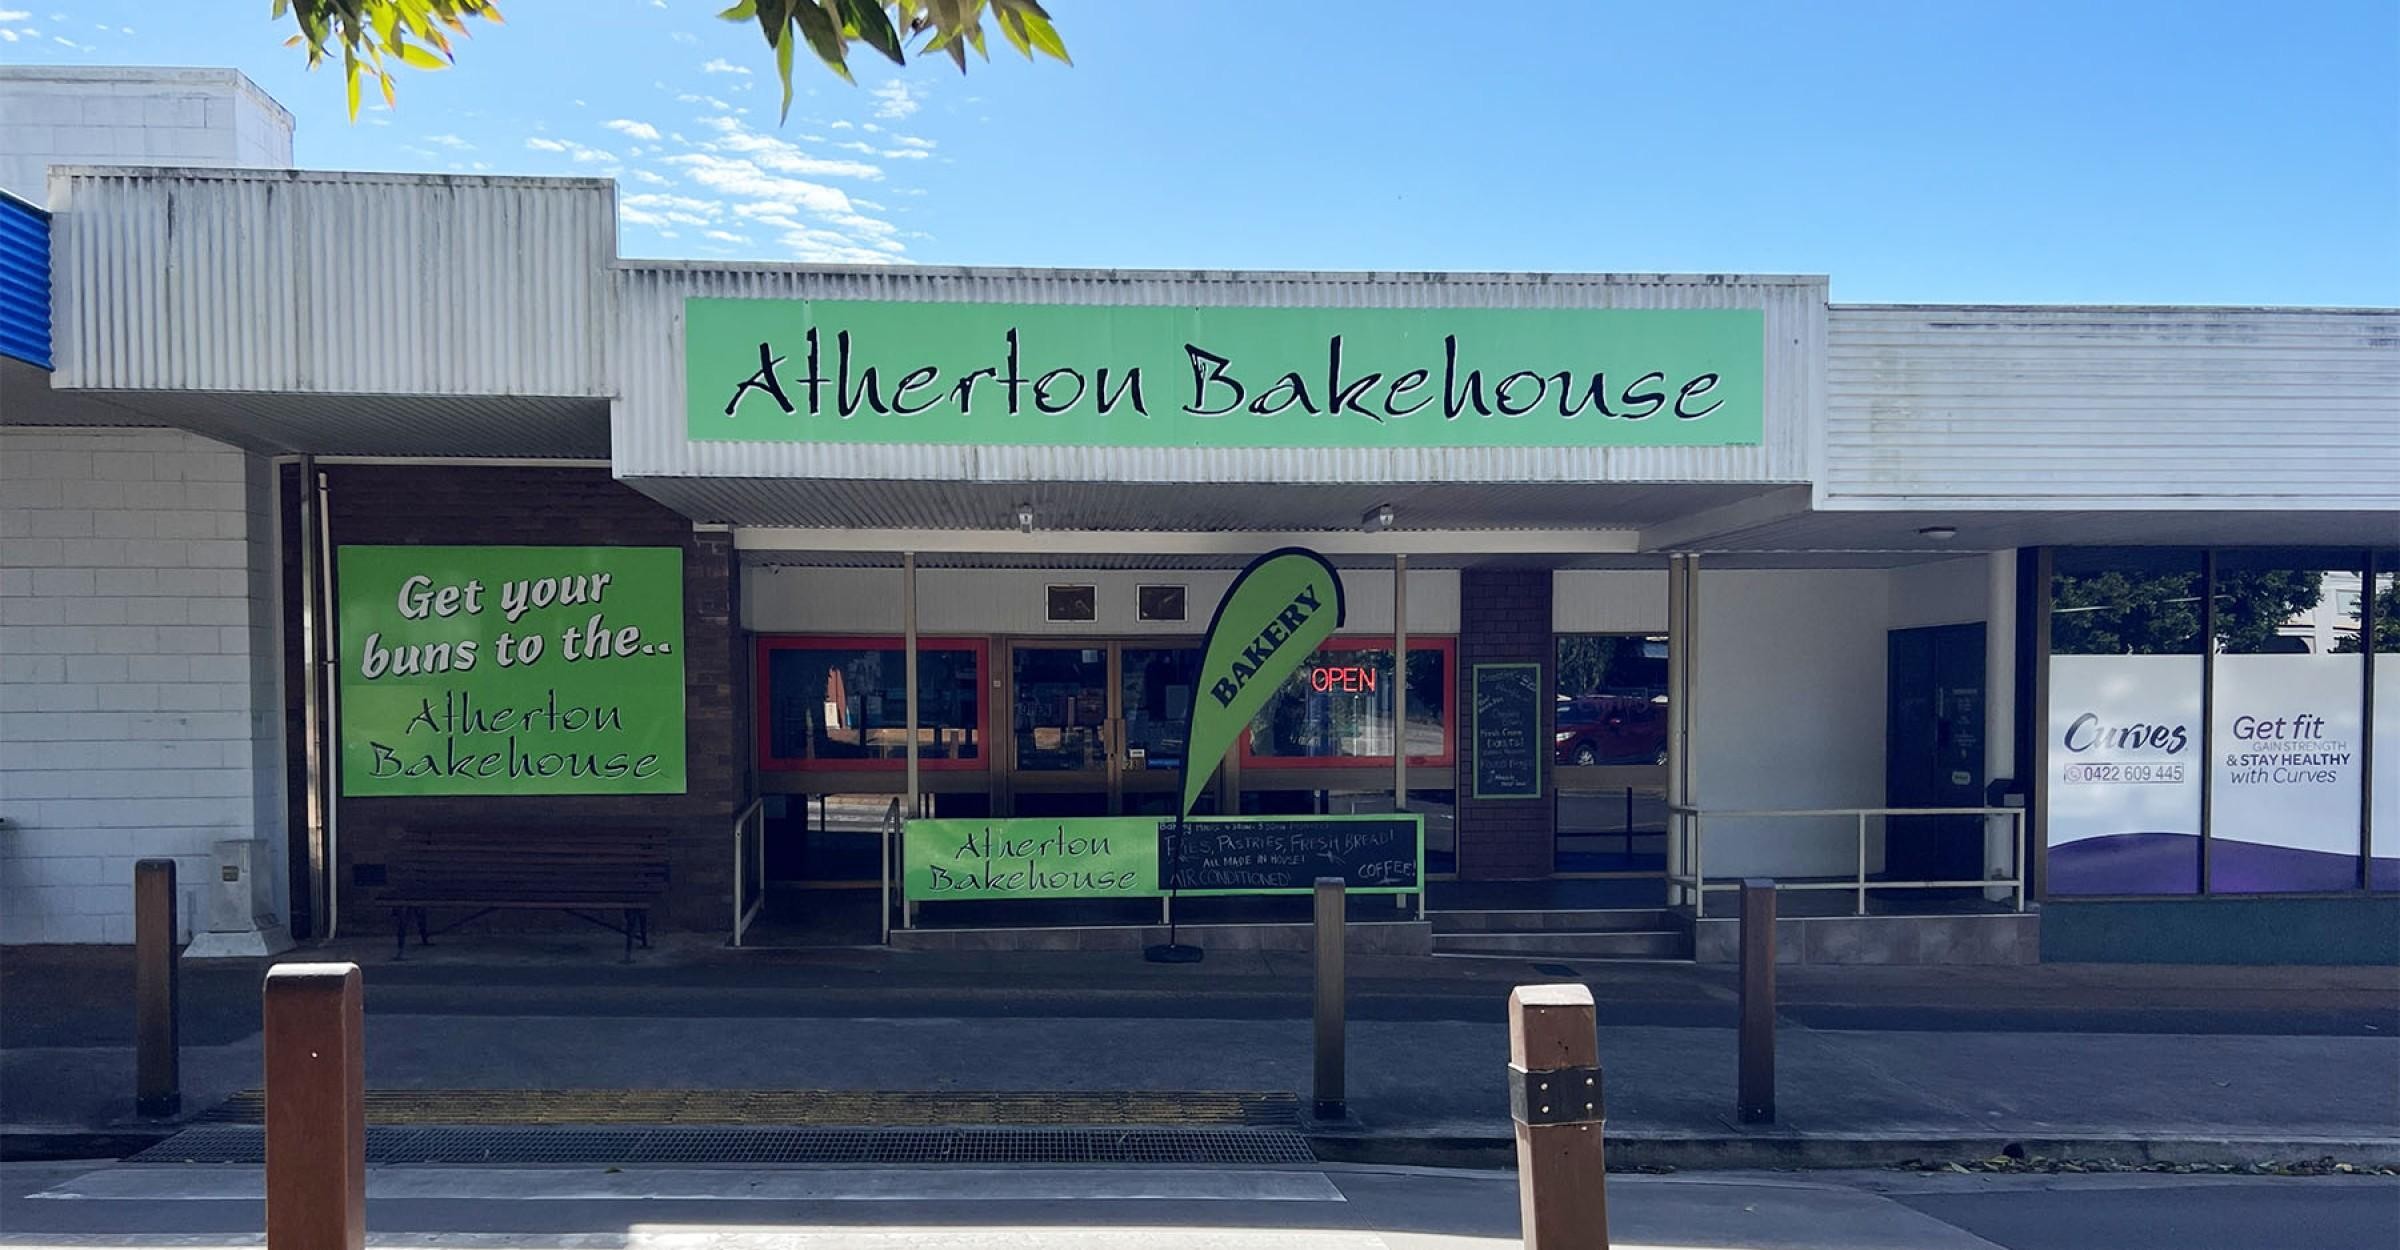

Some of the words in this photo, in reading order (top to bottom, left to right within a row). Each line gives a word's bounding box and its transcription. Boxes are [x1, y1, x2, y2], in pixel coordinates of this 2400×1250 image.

[725, 327, 1150, 418] Atherton
[1182, 334, 1725, 423] Bakehouse
[398, 575, 484, 619] Get
[500, 570, 612, 622] your
[360, 632, 479, 680] buns
[495, 631, 545, 667] to
[562, 613, 673, 662] the..
[1210, 584, 1322, 709] BAKERY
[1311, 667, 1376, 693] OPEN
[406, 688, 622, 736] Atherton
[2233, 715, 2286, 740] Get
[2292, 714, 2325, 740] fit
[2064, 712, 2187, 755] Curves
[2253, 741, 2282, 752] GAIN
[2283, 741, 2347, 752] STRENGTH
[368, 735, 661, 780] Bakehouse
[2084, 766, 2120, 781] 0422
[2124, 766, 2151, 781] 609
[2156, 766, 2182, 781] 445
[2226, 754, 2238, 766] &
[2240, 754, 2278, 766] STAY
[2281, 753, 2351, 766] HEALTHY
[2231, 767, 2269, 784] with
[2273, 767, 2337, 784] Curves
[955, 825, 1111, 860] Atherton
[1290, 833, 1339, 853] FRESH
[929, 859, 1137, 892] Bakehouse
[1223, 855, 1252, 867] MADE
